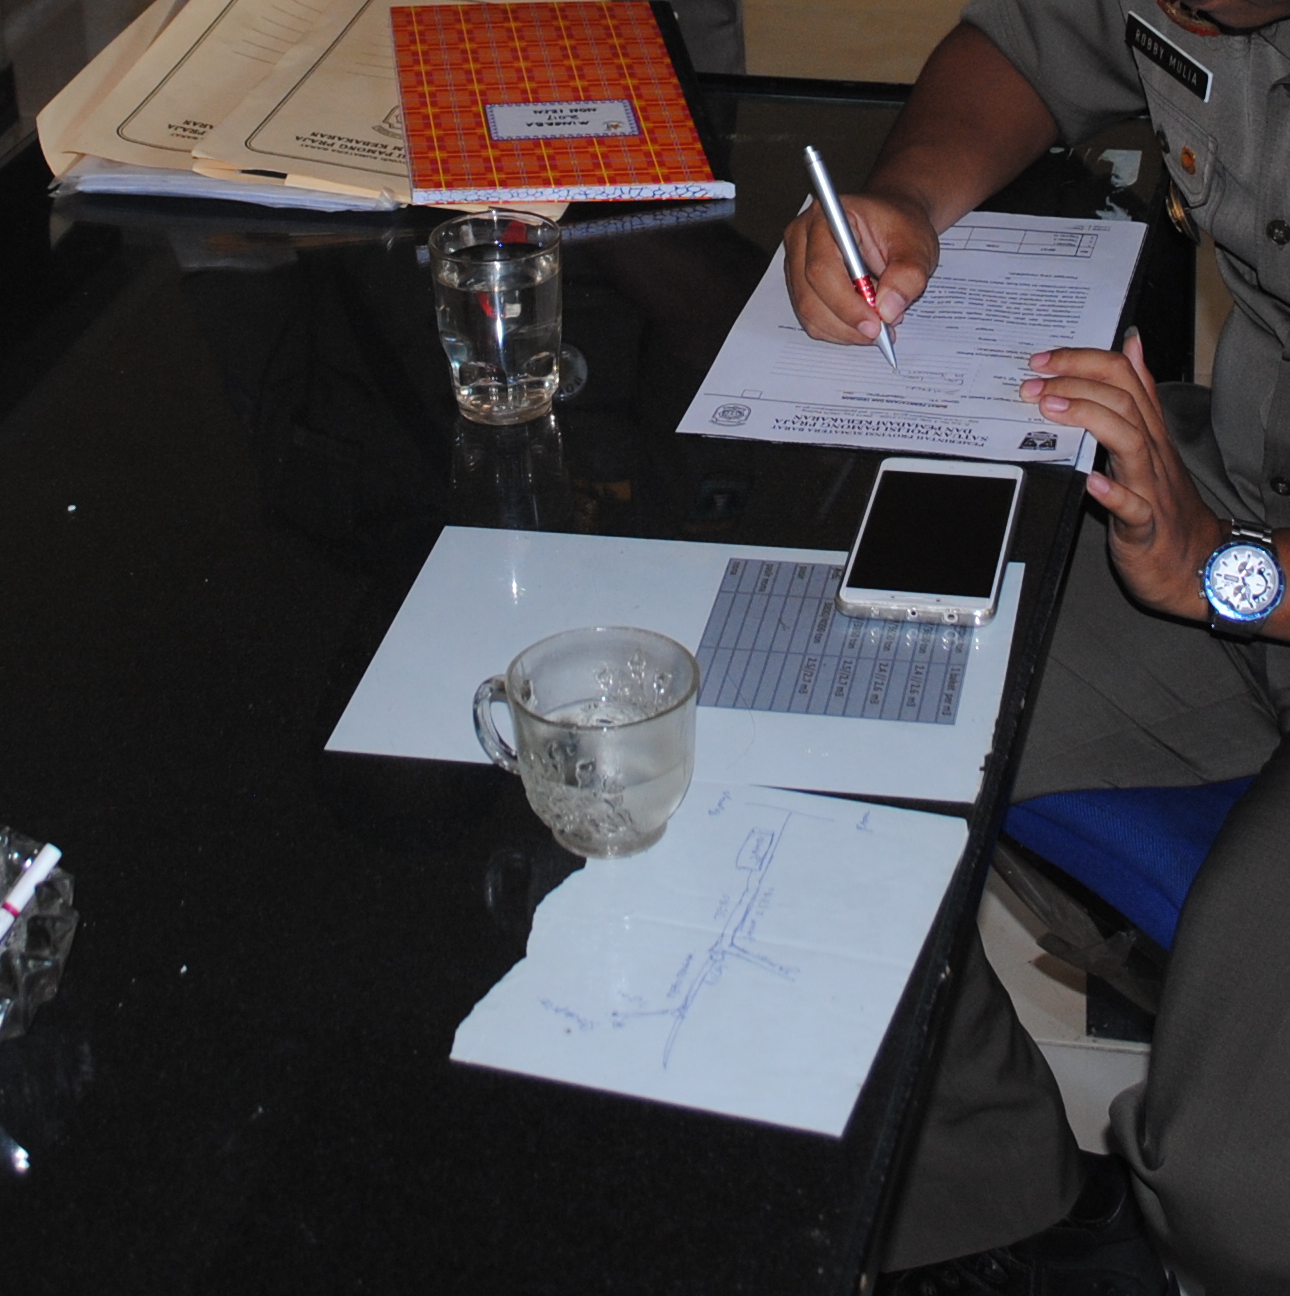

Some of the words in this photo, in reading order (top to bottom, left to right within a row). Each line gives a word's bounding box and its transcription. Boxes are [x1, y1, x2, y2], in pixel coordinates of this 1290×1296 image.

[1135, 29, 1165, 61] ROBBY
[1168, 54, 1198, 86] MULIA
[167, 123, 207, 136] PRAJA
[294, 135, 335, 148] PRAJA
[310, 131, 389, 150] KEBAKARAN
[331, 149, 378, 160] SUMATERA
[339, 144, 392, 157] PAMONG
[774, 418, 817, 428] PRAJA
[793, 414, 871, 426] KEBAKARAN
[876, 420, 940, 430] PEMADAM
[820, 421, 878, 432] PAMONG
[884, 425, 930, 436] POLISI
[943, 426, 973, 434] DAN
[807, 428, 865, 438] SUMATERA
[866, 431, 915, 440] PROVINSI
[931, 430, 989, 442] SATUAN
[916, 434, 985, 447] PEMERINTAH
